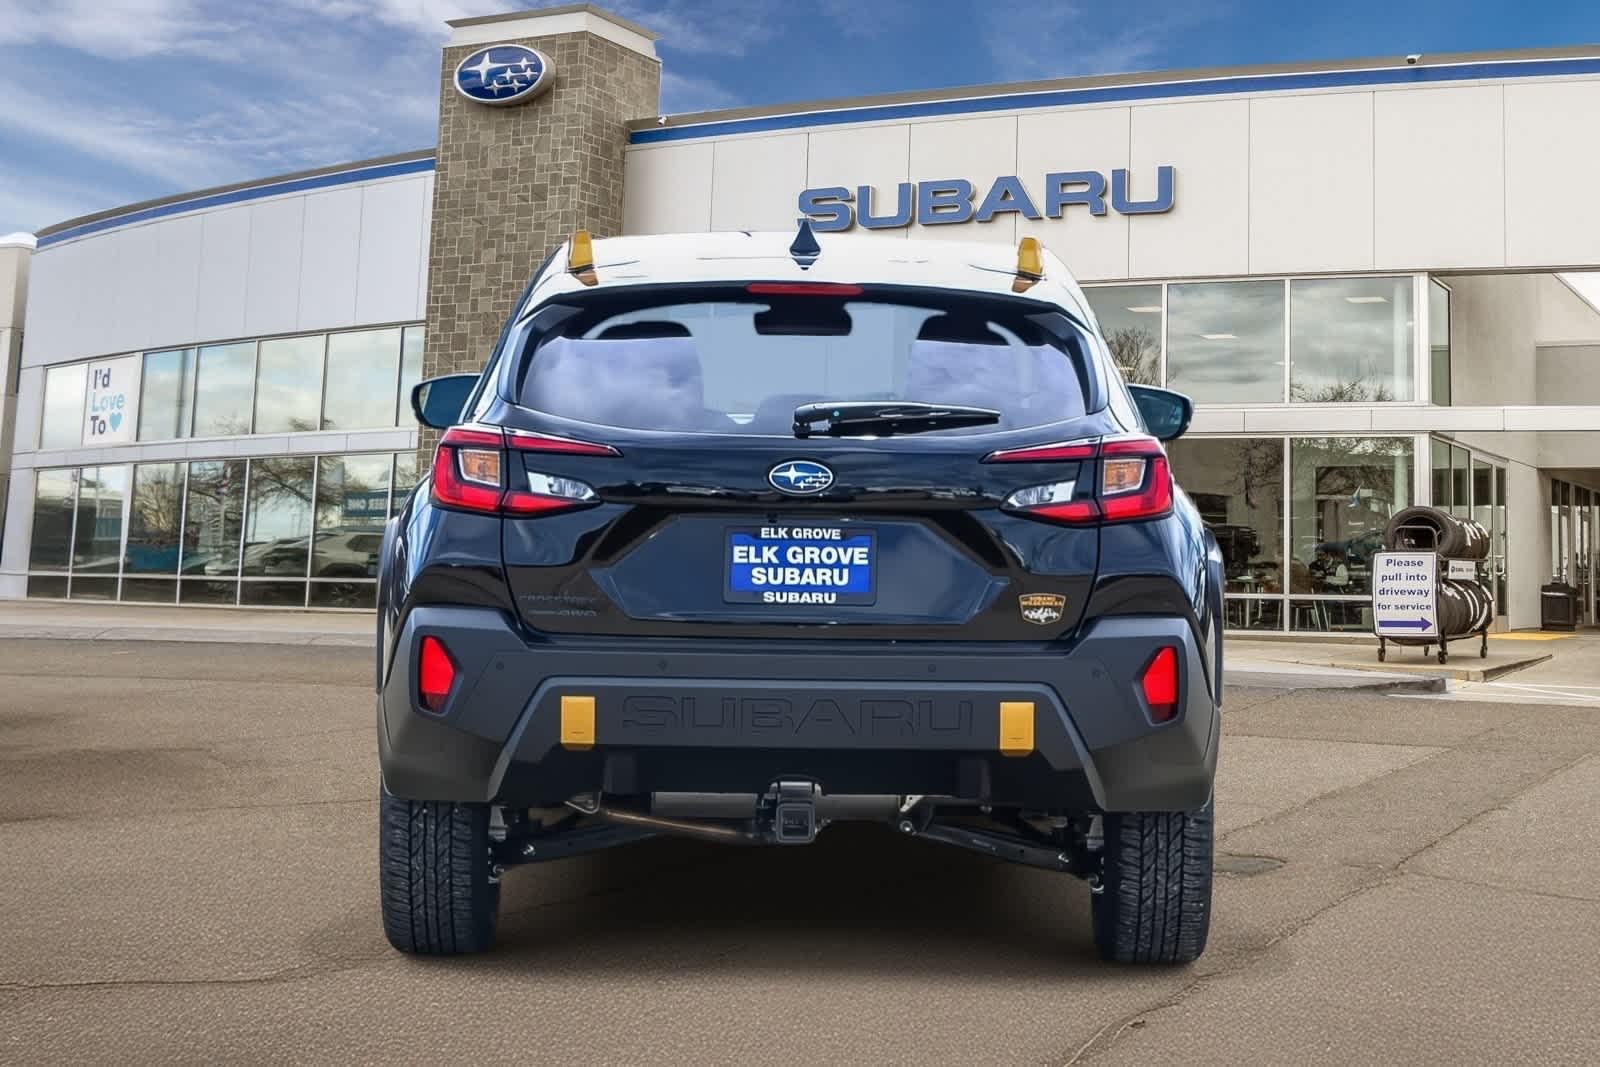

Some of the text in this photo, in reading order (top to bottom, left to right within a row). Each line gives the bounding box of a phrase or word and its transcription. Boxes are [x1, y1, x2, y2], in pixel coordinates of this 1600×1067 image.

[797, 165, 1175, 232] SUBARU
[94, 367, 111, 389] I'd
[91, 391, 125, 412] Love
[90, 415, 106, 435] To
[760, 527, 841, 540] ELK GROVE
[733, 546, 869, 565] ELK GROVE
[1386, 558, 1424, 567] Please
[751, 567, 849, 585] SUBARU
[1381, 572, 1428, 583] pull into
[763, 591, 837, 604] SUBARU
[1378, 587, 1430, 597] driveway
[622, 695, 974, 736] SUBARU
